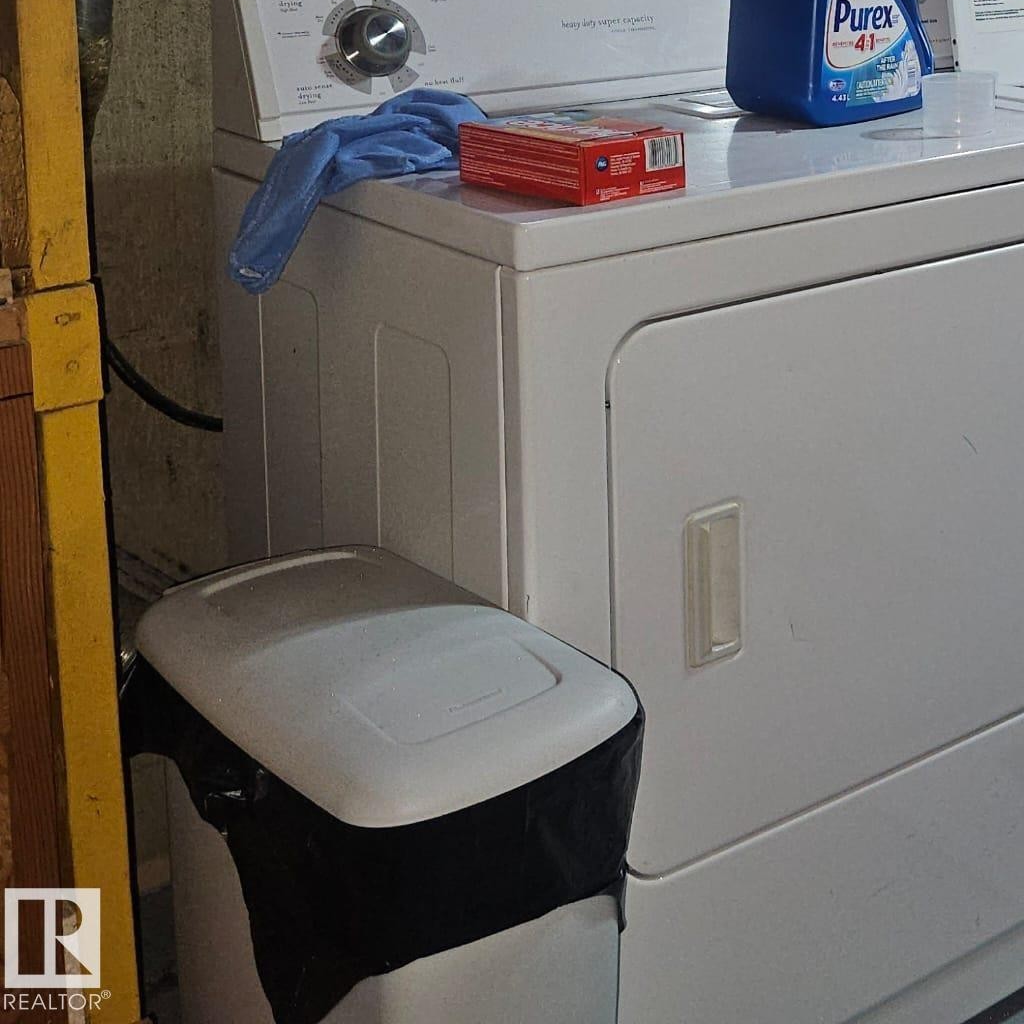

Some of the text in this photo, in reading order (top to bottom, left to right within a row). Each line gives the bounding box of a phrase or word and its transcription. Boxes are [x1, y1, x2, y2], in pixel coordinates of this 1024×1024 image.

[561, 13, 655, 31] heavy duty super capacity
